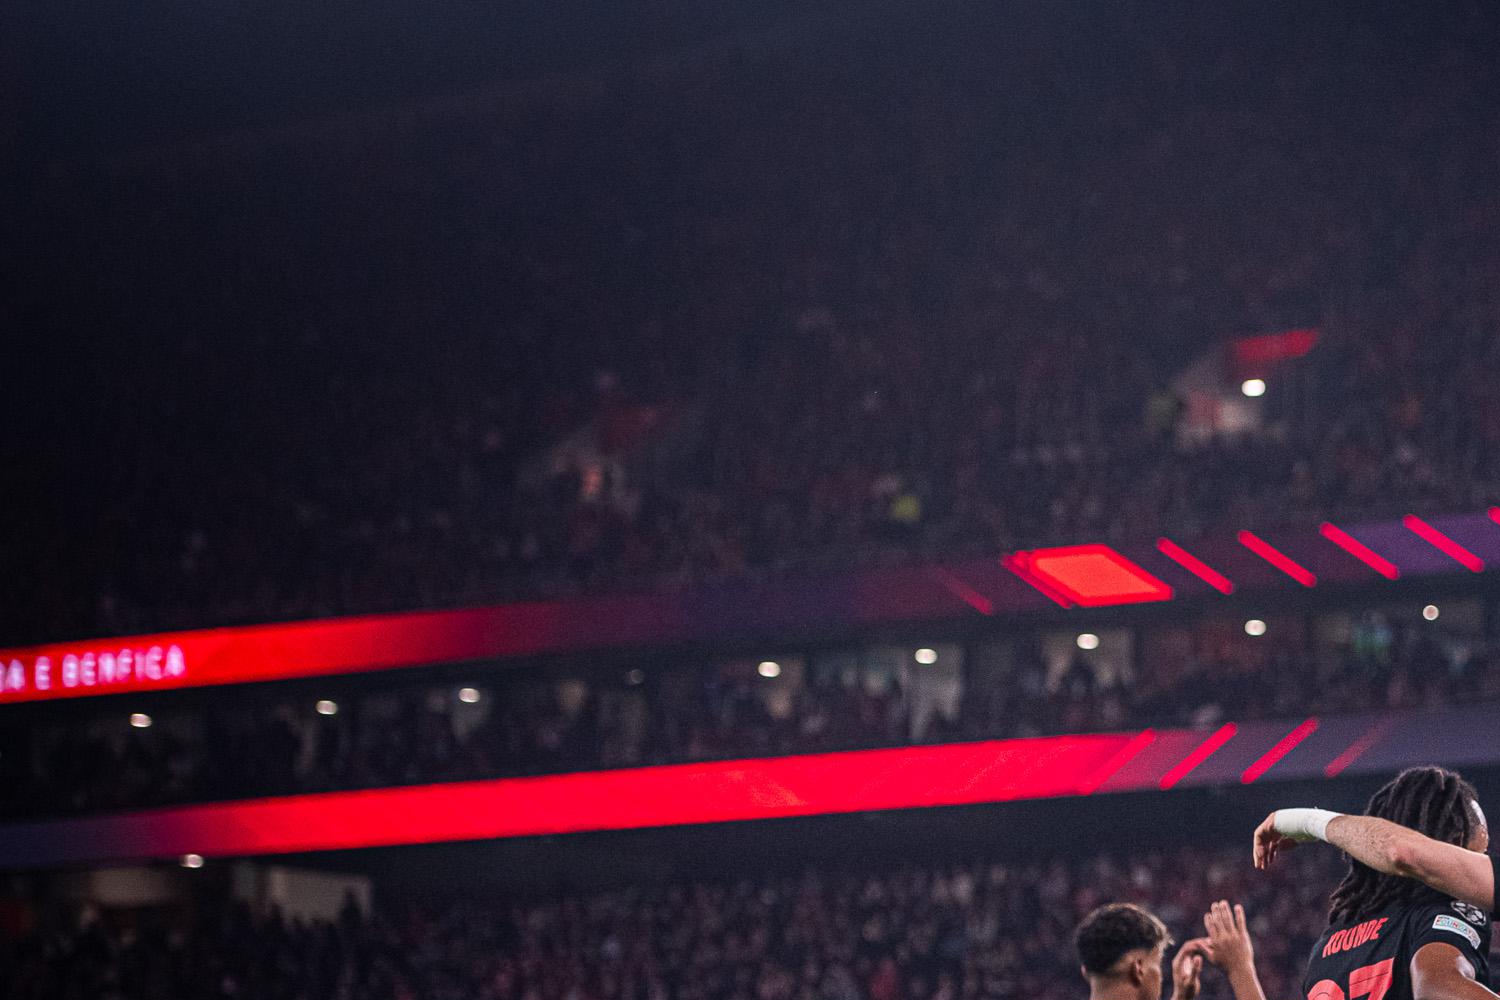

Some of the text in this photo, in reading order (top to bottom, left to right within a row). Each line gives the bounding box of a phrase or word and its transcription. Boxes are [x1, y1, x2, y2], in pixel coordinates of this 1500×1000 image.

[35, 656, 51, 690] E
[62, 645, 186, 688] BENFICA
[1322, 917, 1389, 958] KOUNDE
